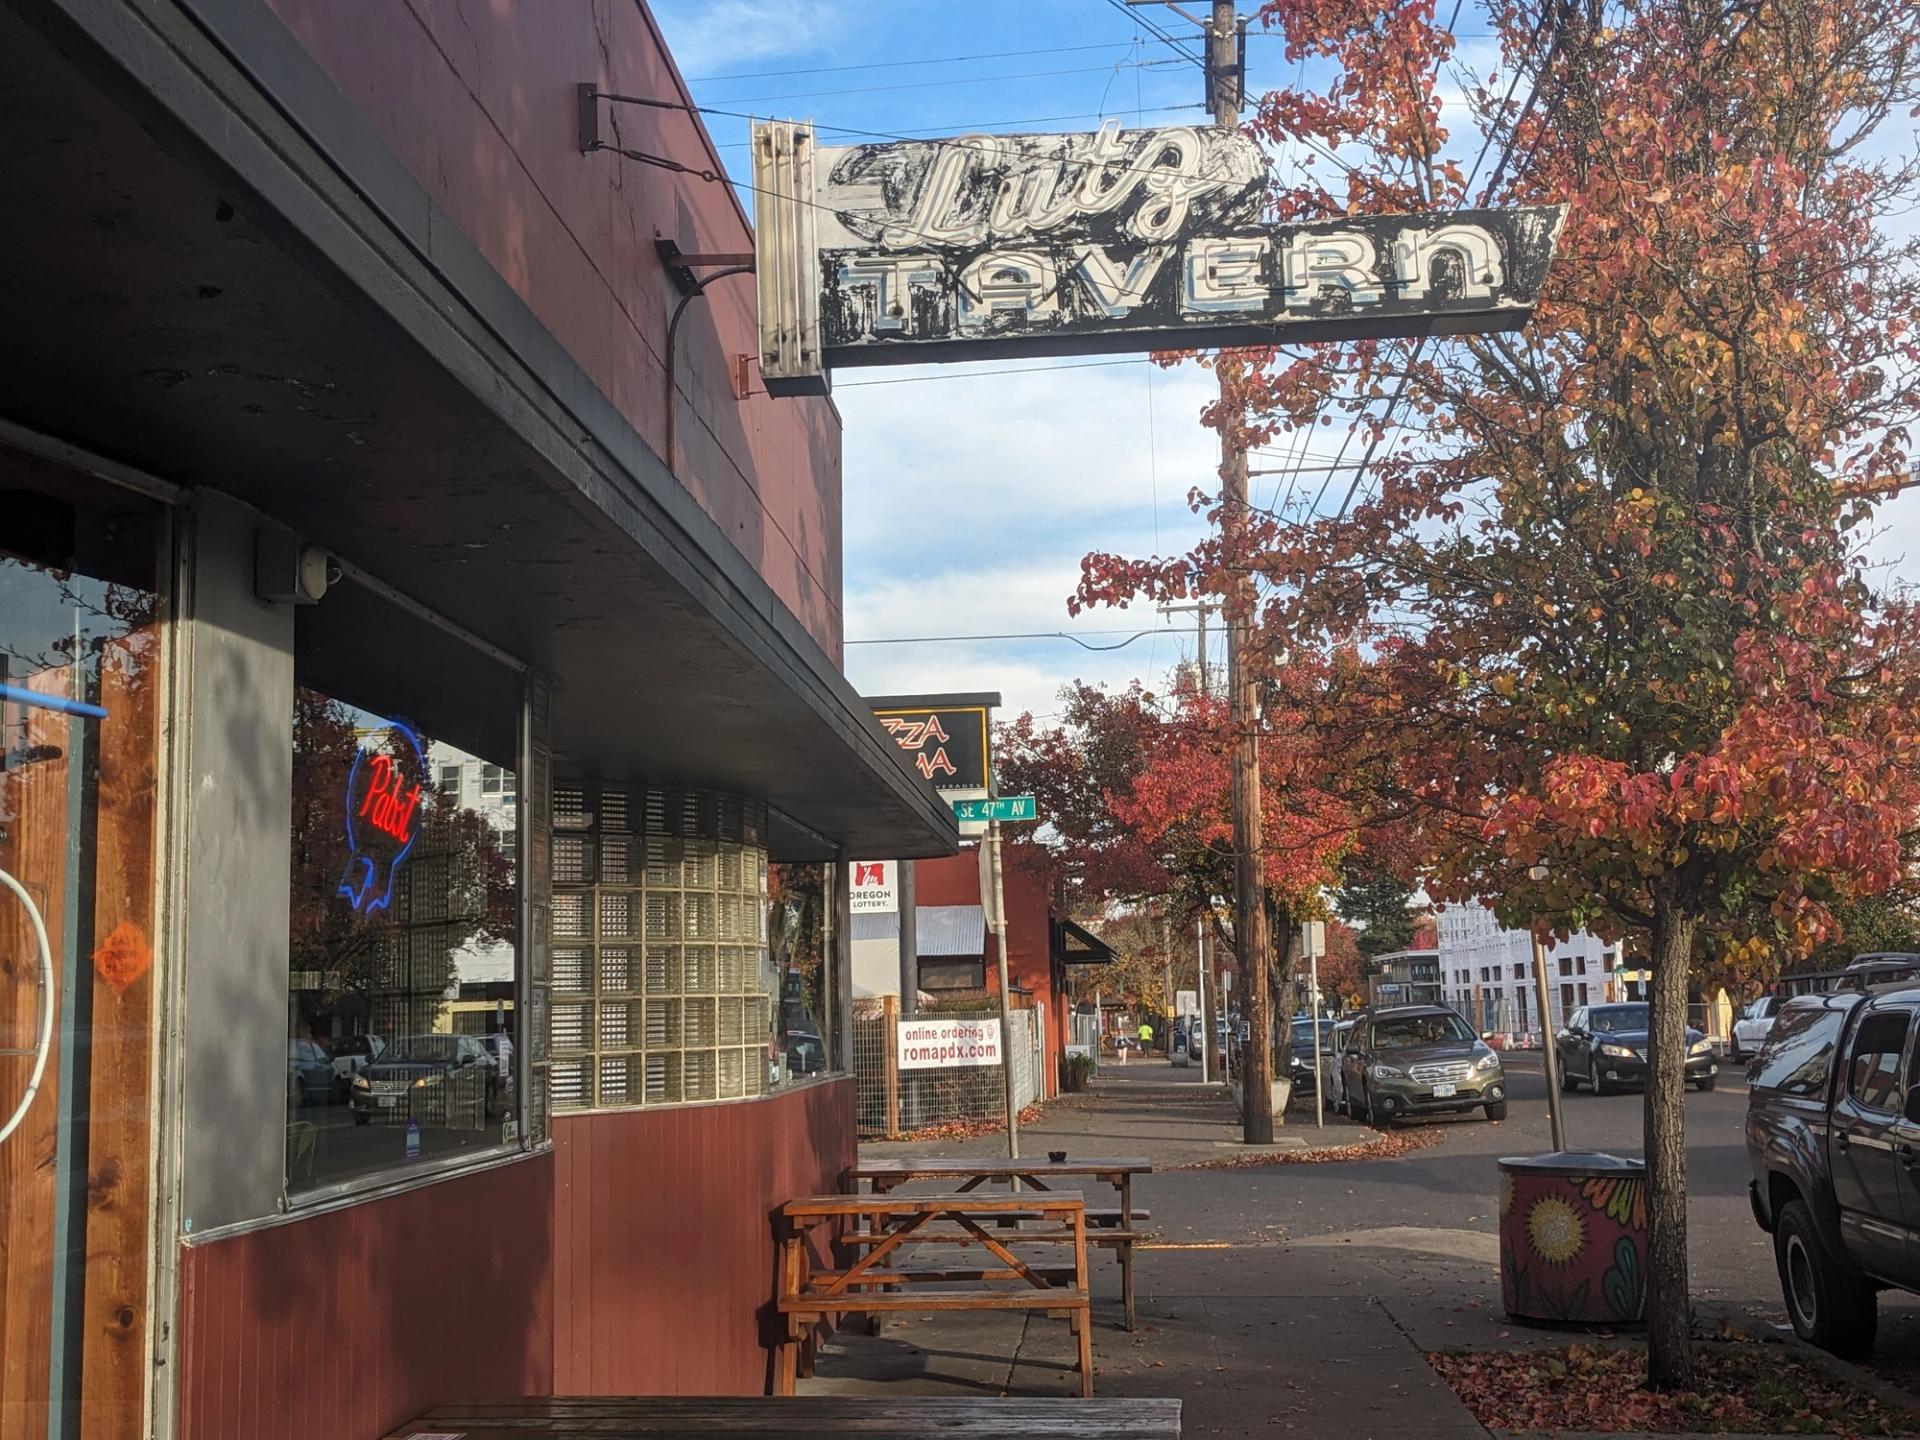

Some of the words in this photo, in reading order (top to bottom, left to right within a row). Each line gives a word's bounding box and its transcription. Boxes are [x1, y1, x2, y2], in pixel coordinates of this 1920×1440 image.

[881, 119, 1230, 248] Lutz
[359, 755, 421, 842] Pabst
[960, 803, 975, 818] SE
[981, 802, 1005, 817] 47TH
[1011, 800, 1025, 816] AV
[849, 890, 891, 900] OREGON
[905, 1027, 938, 1041] online
[941, 1026, 984, 1041] ordering
[903, 1042, 997, 1064] romapdx.com
